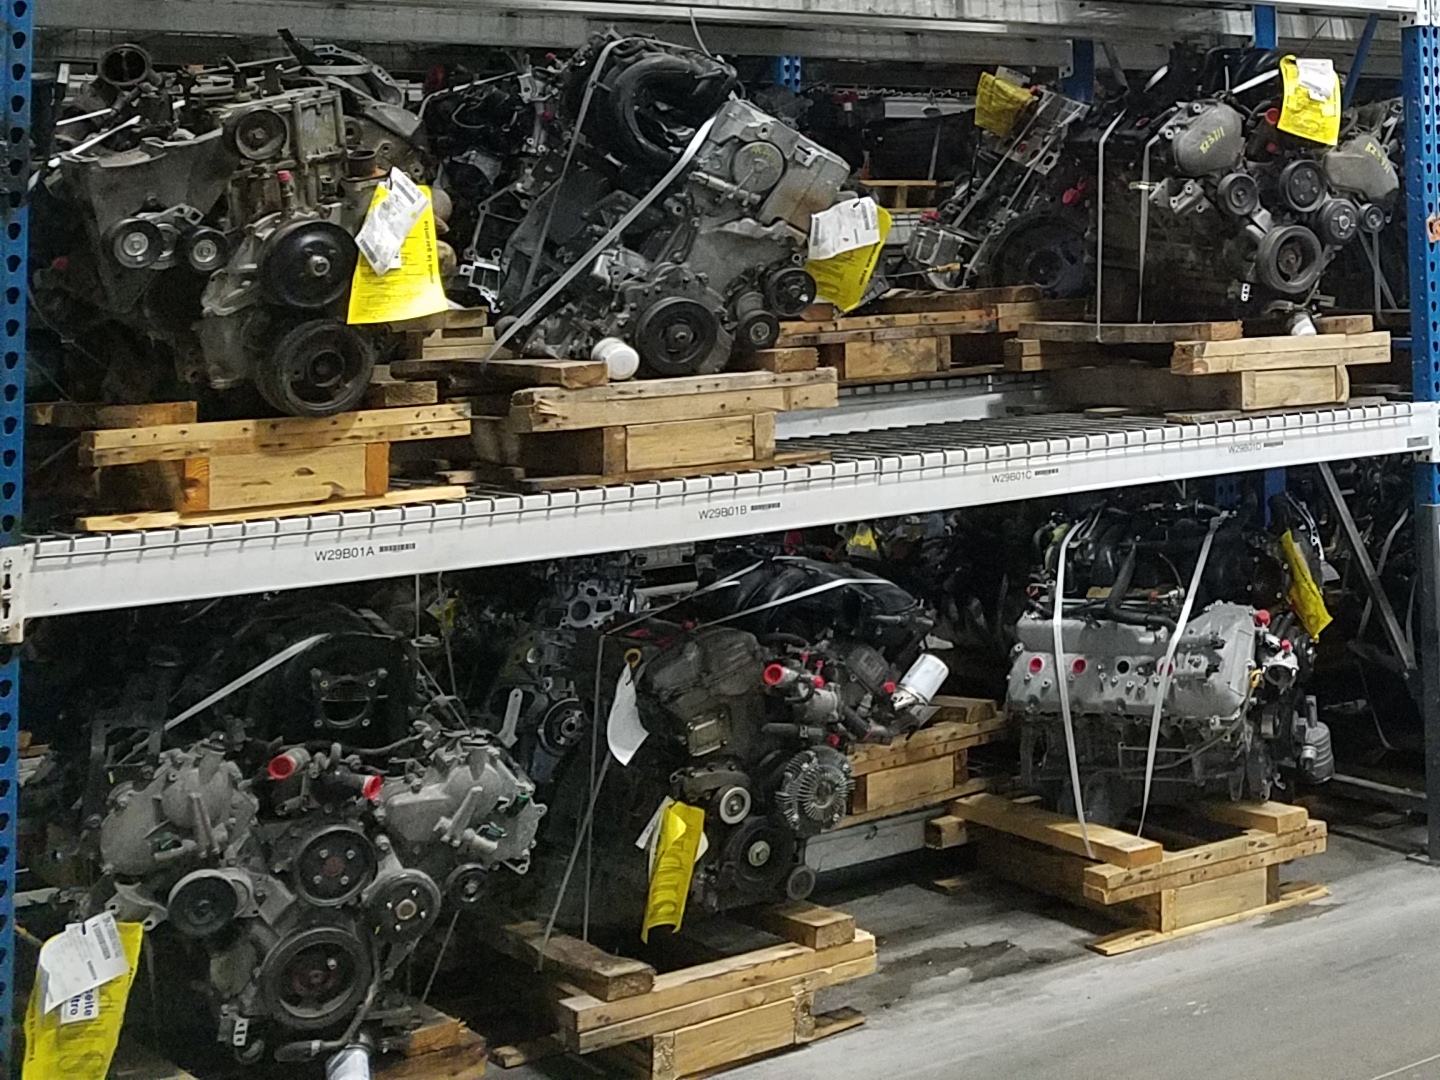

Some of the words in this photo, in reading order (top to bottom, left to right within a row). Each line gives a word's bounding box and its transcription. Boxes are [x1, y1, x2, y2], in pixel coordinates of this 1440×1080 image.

[991, 472, 1032, 484] W29B01C
[698, 505, 747, 520] W29B01B
[314, 546, 375, 561] W29B01A
